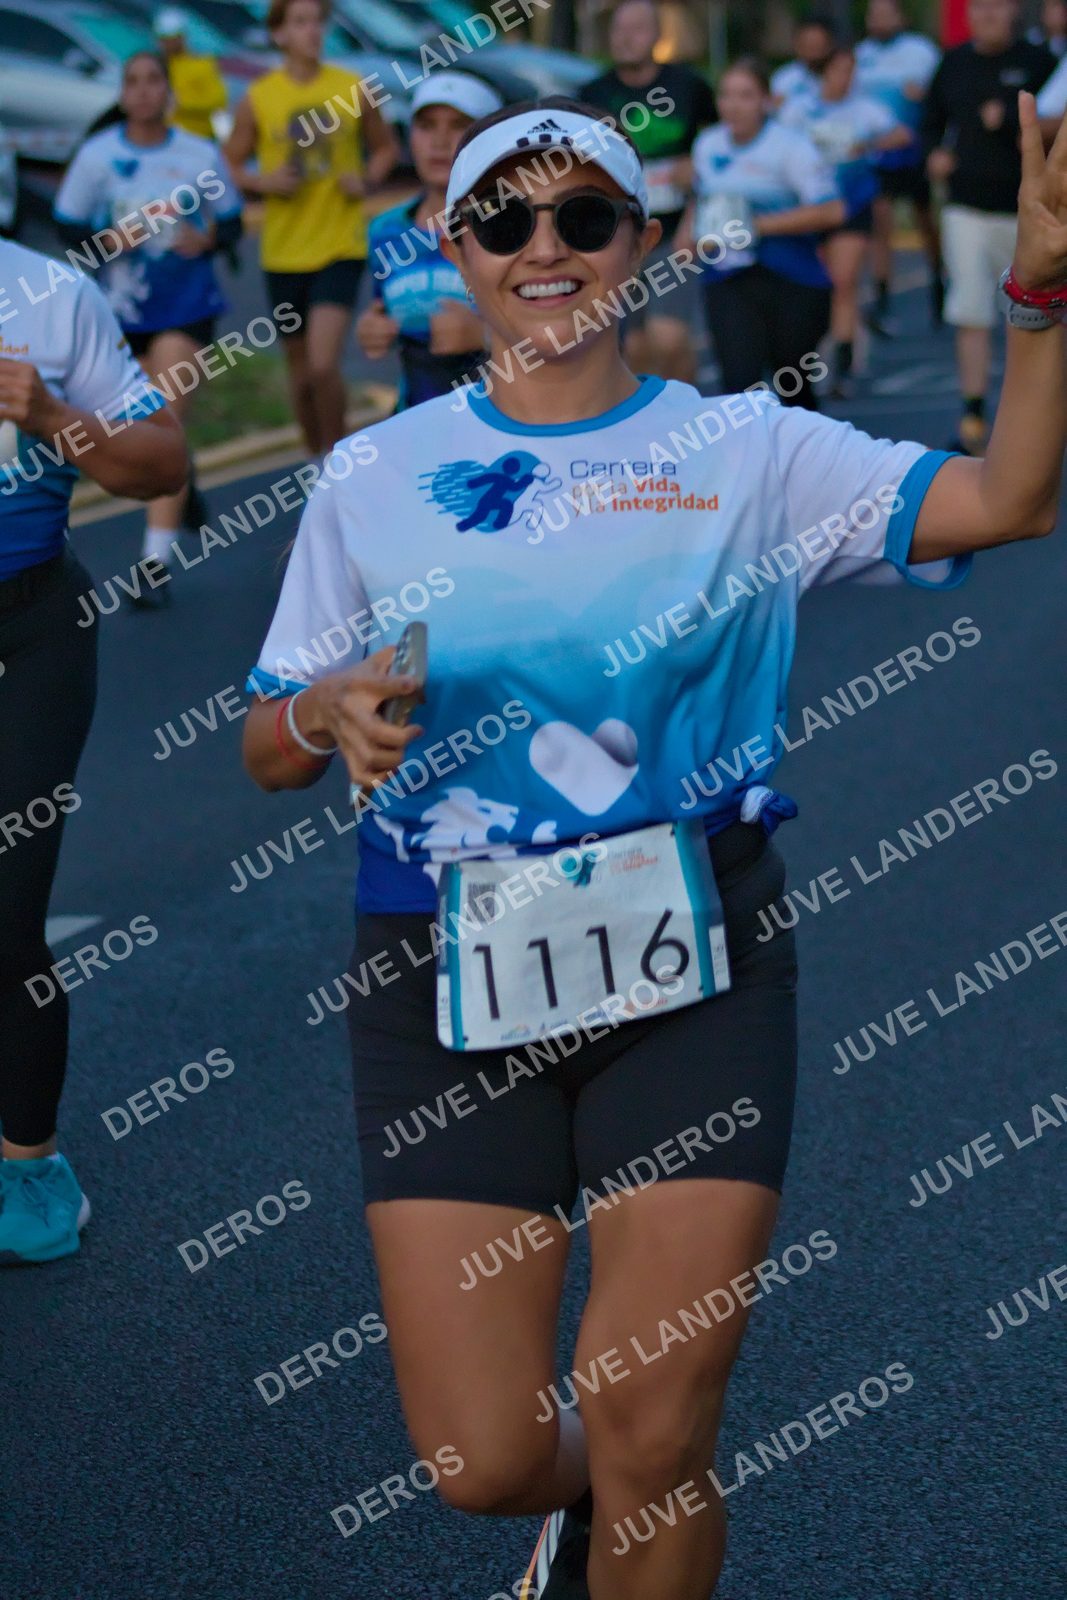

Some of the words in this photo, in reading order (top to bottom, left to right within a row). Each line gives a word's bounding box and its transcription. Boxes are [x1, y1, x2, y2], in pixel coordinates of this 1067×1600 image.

[570, 459, 677, 479] Carrera
[634, 477, 681, 493] Vida
[612, 493, 719, 513] Integridad
[472, 908, 690, 1020] 1116
